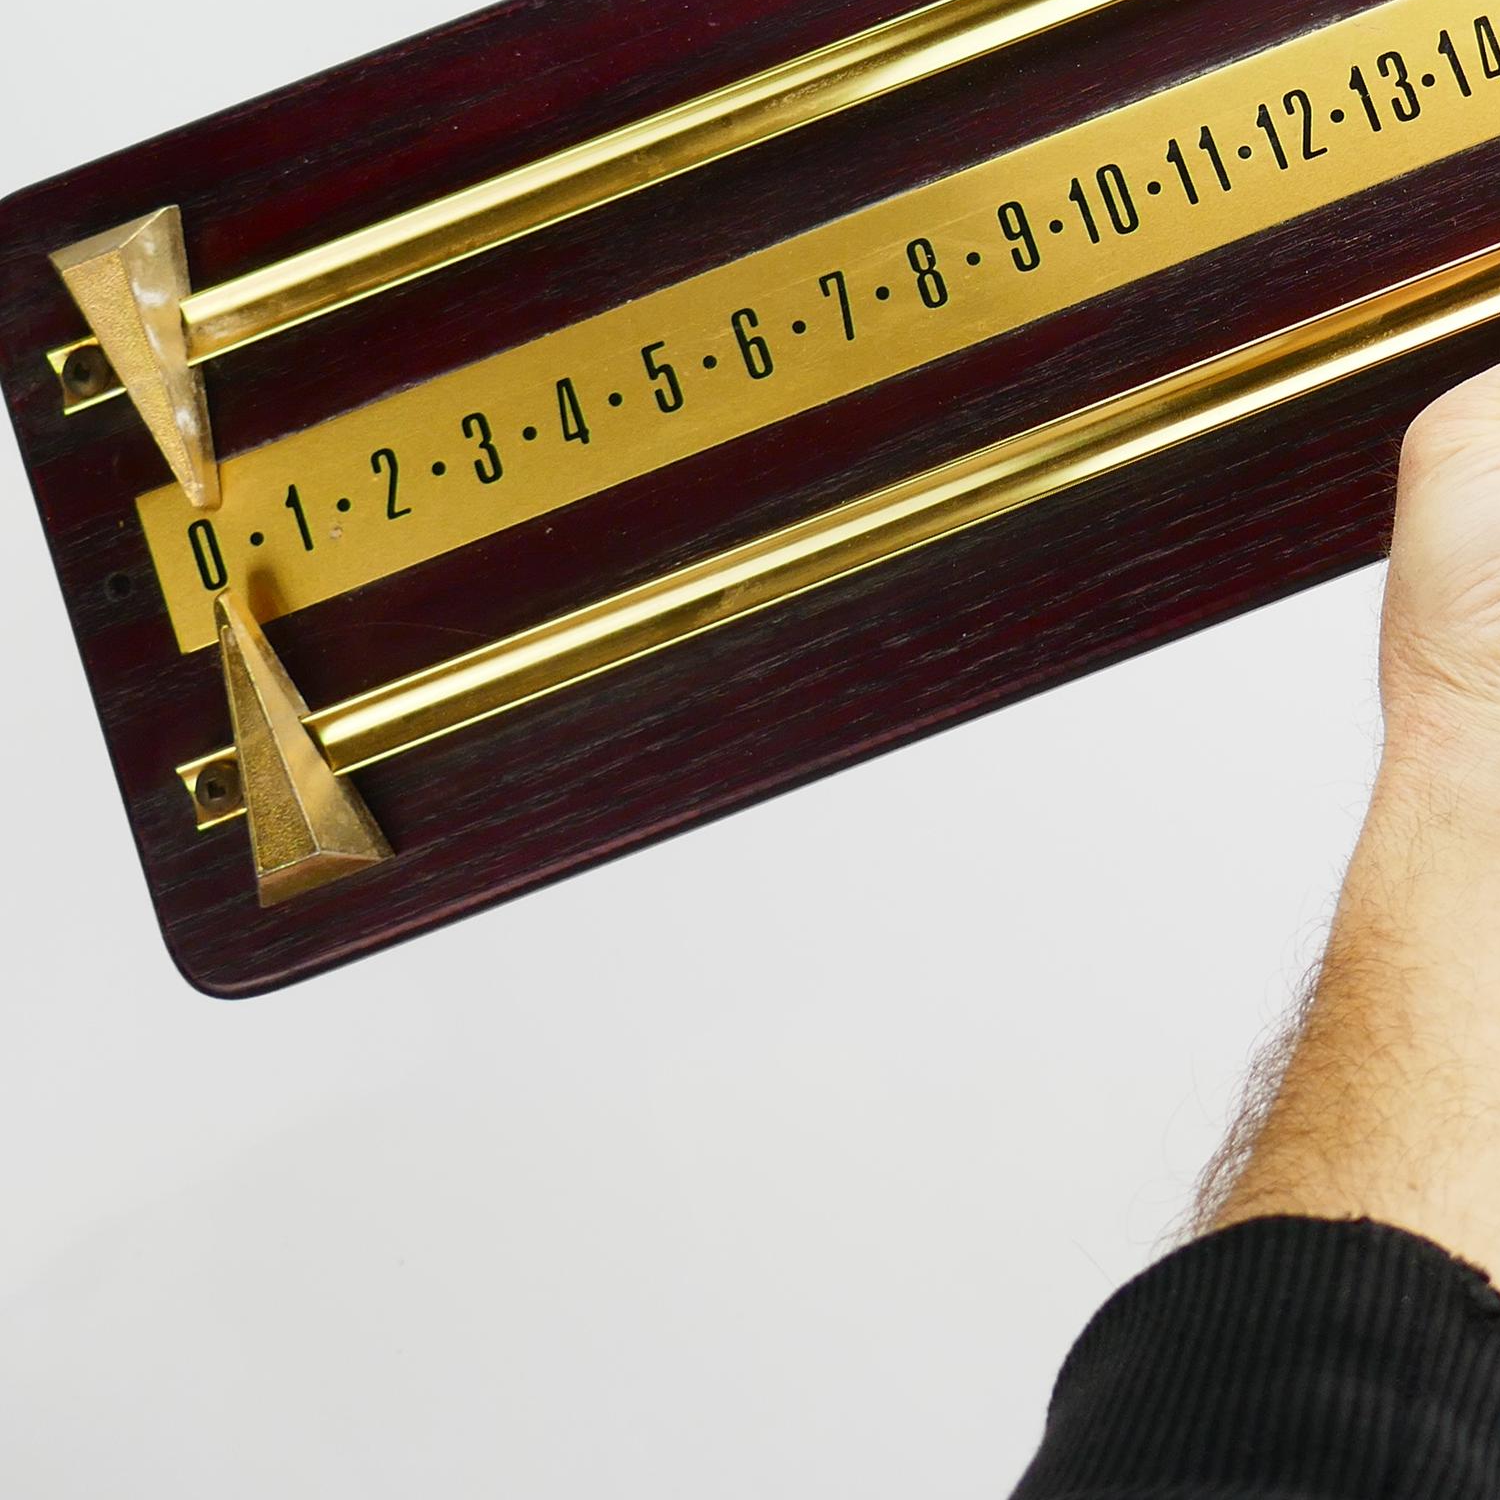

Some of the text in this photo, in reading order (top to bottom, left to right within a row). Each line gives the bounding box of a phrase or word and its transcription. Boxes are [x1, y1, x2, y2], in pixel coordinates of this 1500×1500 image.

[188, 518, 228, 591] 0
[285, 483, 314, 551] 1
[370, 448, 412, 520] 2
[461, 412, 503, 484] 3
[555, 377, 590, 444] 4
[641, 340, 684, 413] 5
[731, 307, 773, 379] 6
[818, 270, 855, 341] 7
[906, 237, 948, 309] 8
[997, 201, 1040, 272] 9
[1068, 163, 1139, 244] 10
[1165, 125, 1232, 205] 11
[1256, 89, 1328, 170] 12
[1348, 51, 1421, 132] 13
